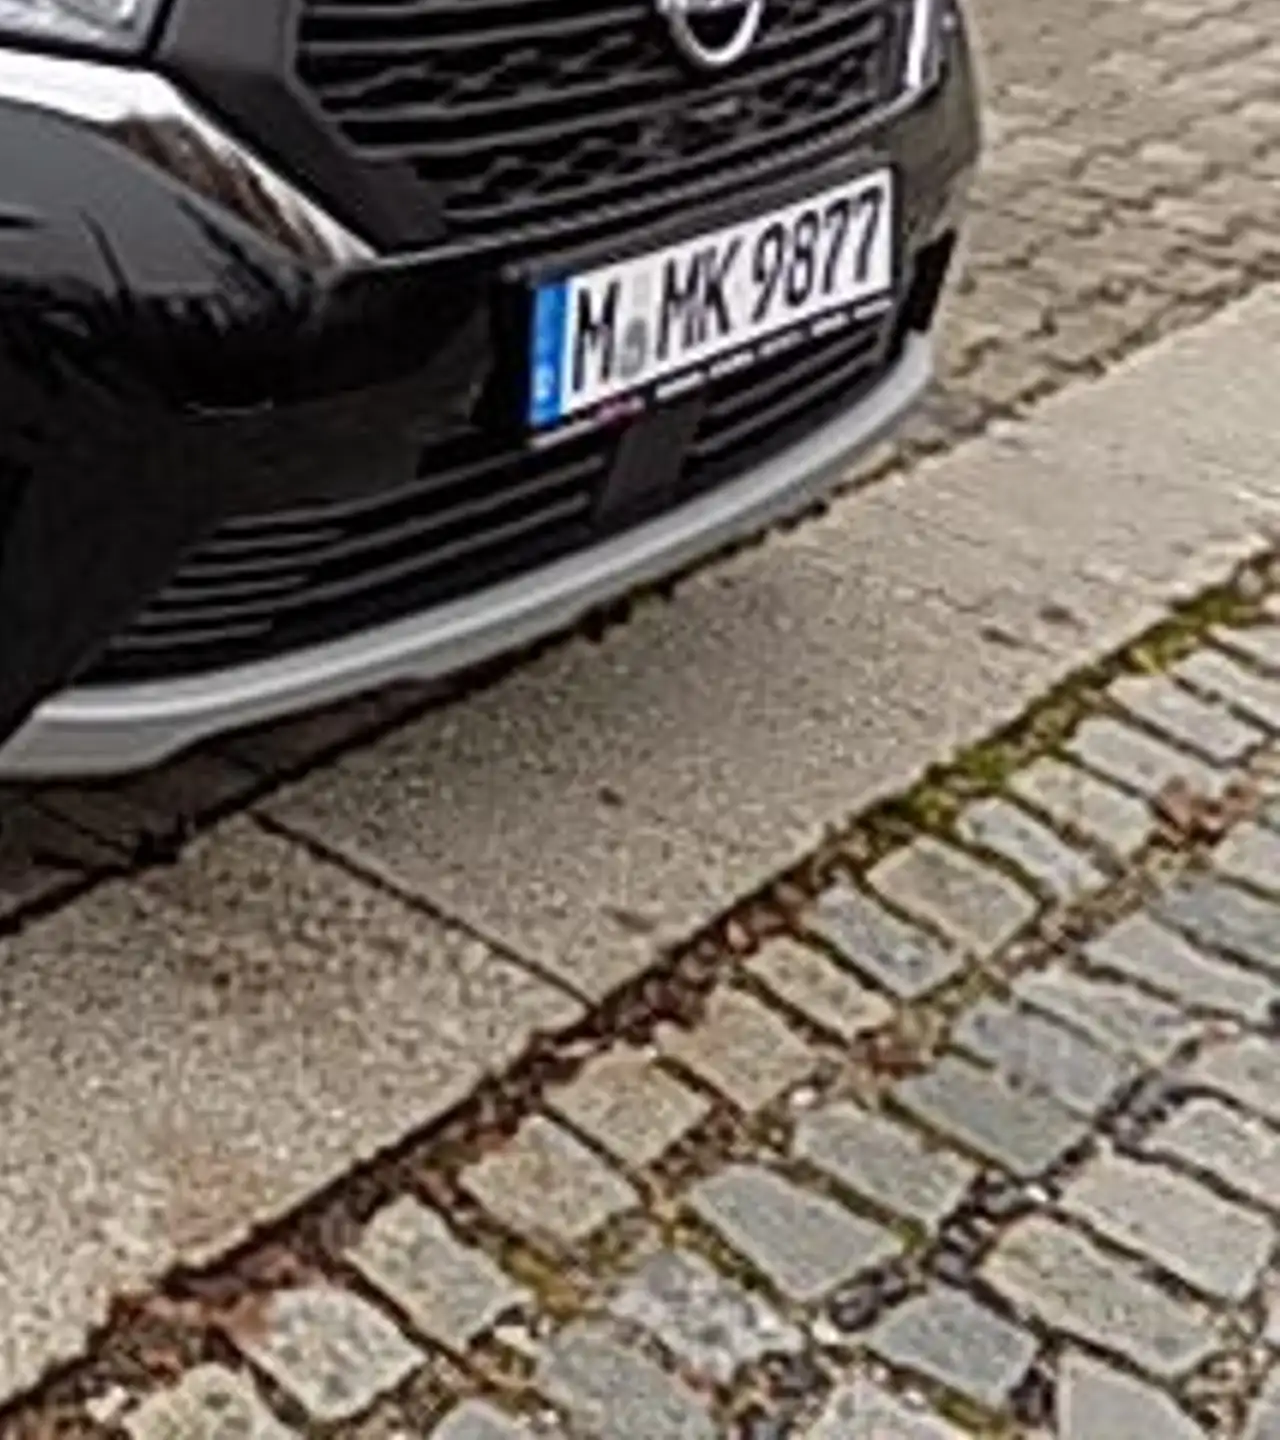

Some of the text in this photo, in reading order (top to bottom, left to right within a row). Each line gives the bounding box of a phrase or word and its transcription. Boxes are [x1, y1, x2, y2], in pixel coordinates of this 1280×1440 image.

[571, 184, 885, 393] M MK 9877
